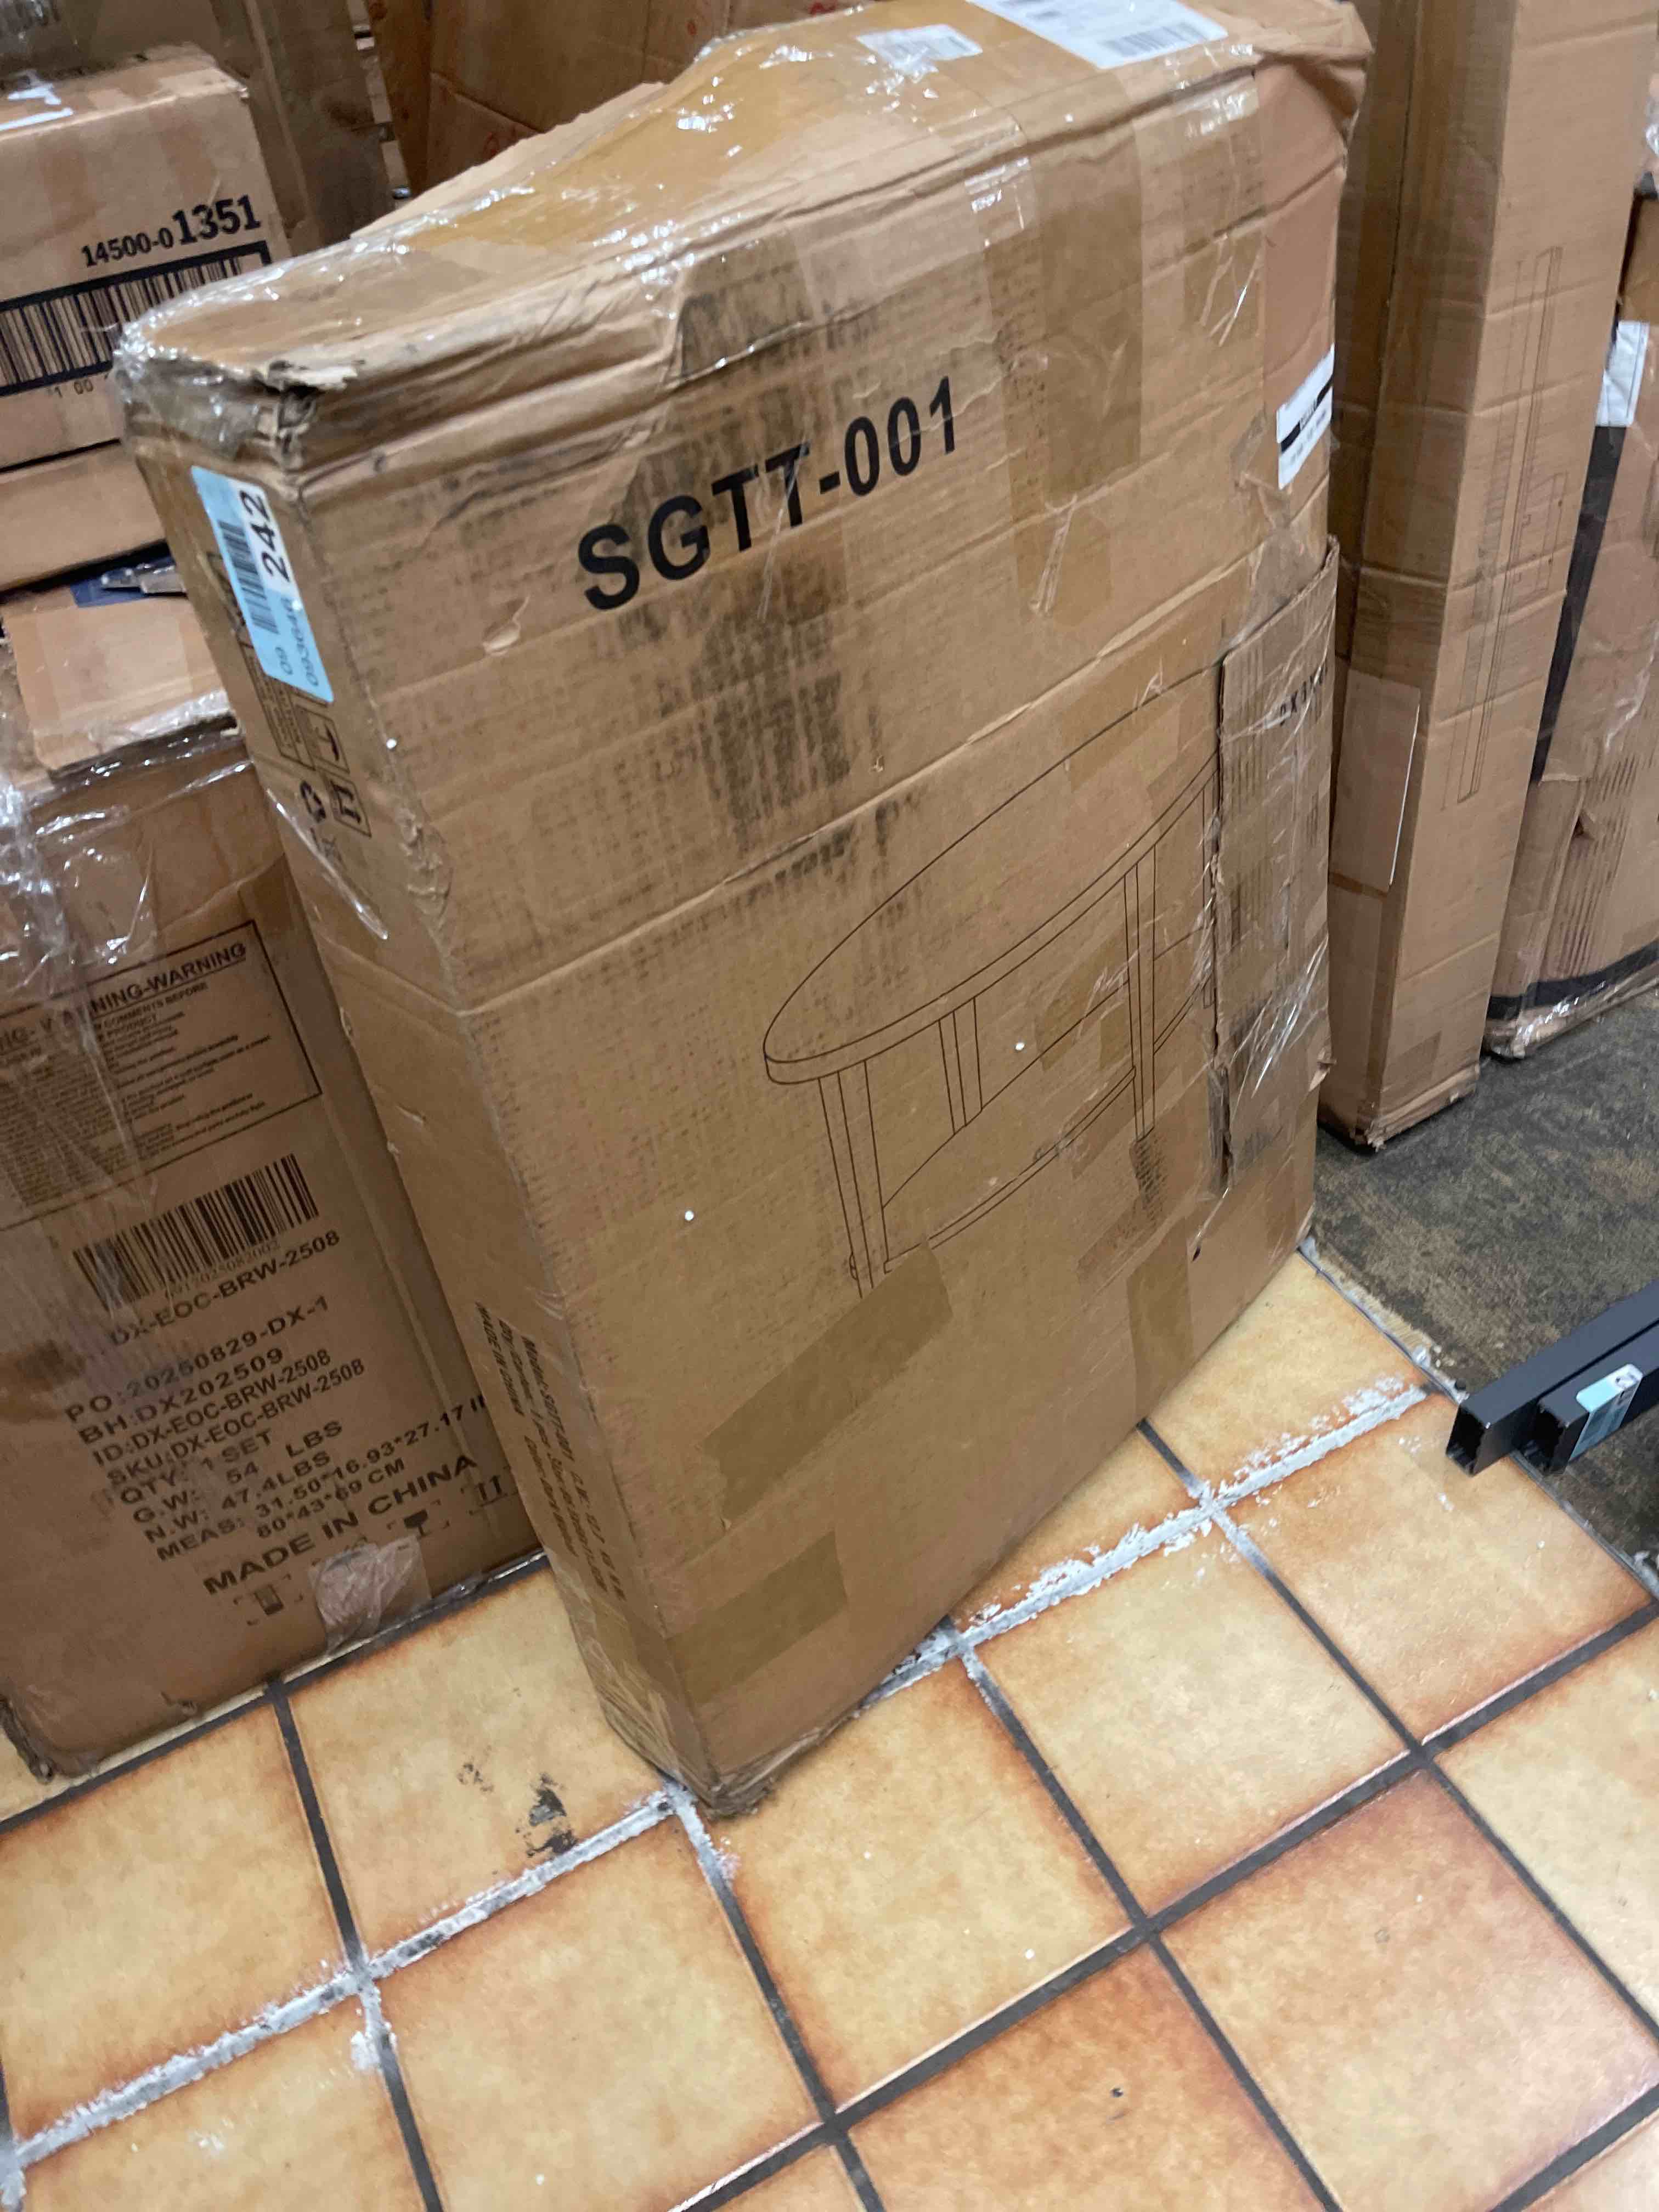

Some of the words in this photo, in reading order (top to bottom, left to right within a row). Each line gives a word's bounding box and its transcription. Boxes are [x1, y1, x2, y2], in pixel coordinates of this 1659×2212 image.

[239, 490, 290, 583] 242
[577, 376, 956, 611] SGTT-001
[110, 1230, 340, 1346] DX-EOC-BRW-2508
[93, 1349, 331, 1466] ID:DX-EOC-BRW-2508
[222, 1428, 272, 1463] SET
[226, 1461, 259, 1484] 54
[285, 1420, 343, 1458] LBS
[367, 1457, 405, 1484] CM
[203, 1533, 316, 1596] MADE
[321, 1510, 359, 1541] IN
[367, 1454, 478, 1516] CHINA
